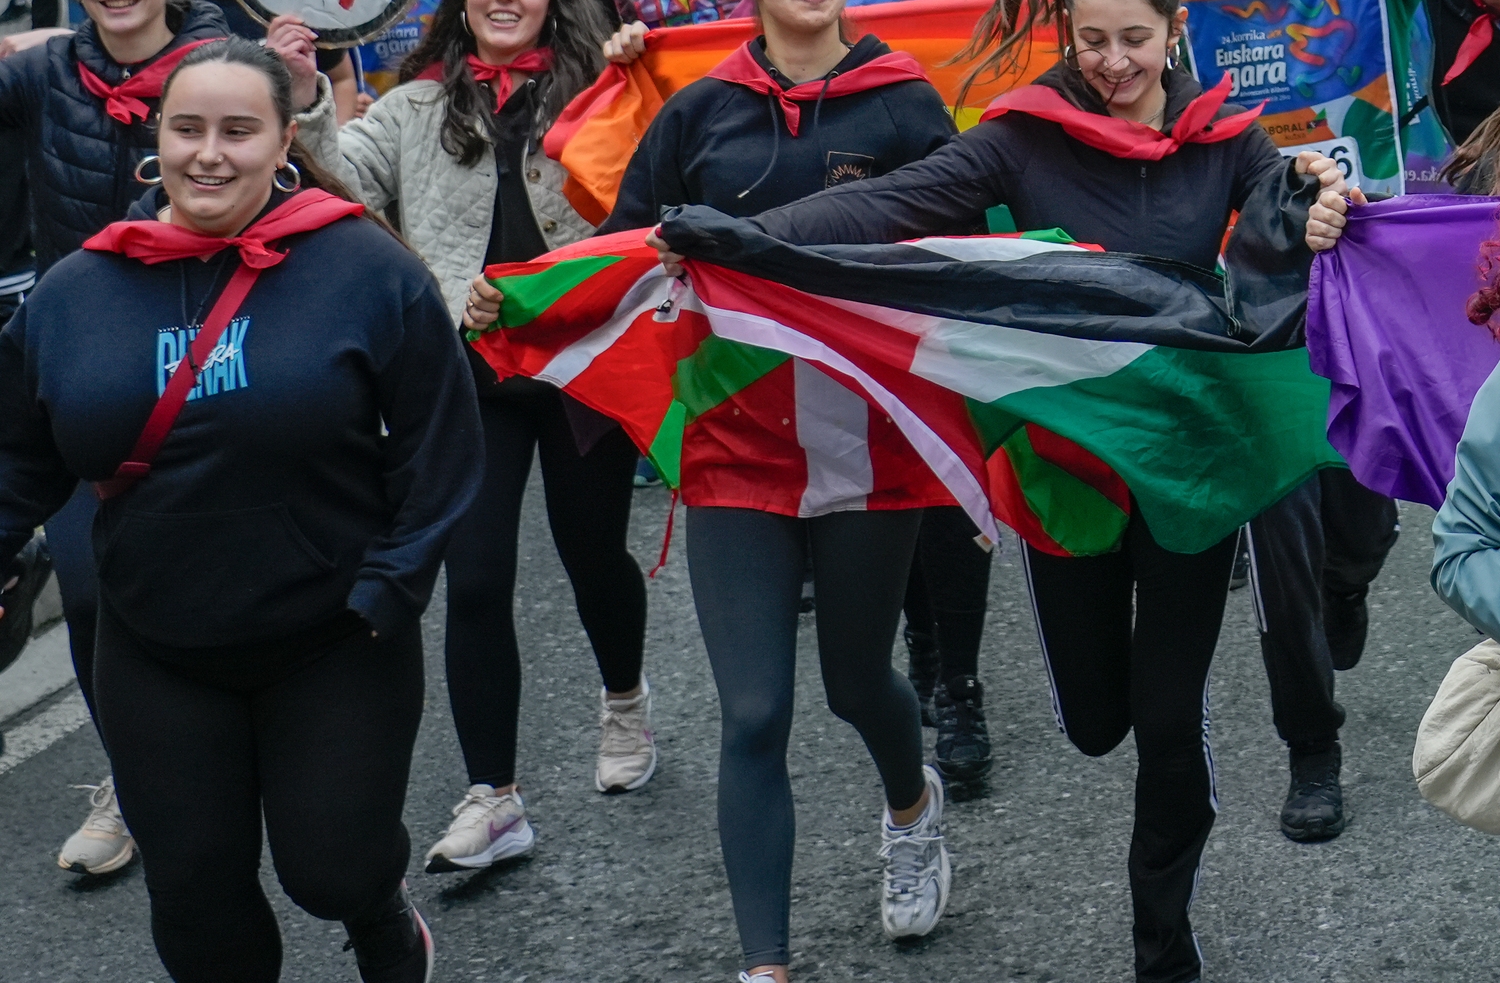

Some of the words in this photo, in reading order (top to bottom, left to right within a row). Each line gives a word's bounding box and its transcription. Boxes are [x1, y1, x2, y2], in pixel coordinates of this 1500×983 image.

[1221, 29, 1266, 45] 24.korrika
[1215, 43, 1284, 67] Euskara
[1228, 61, 1287, 97] gara
[1263, 122, 1304, 135] BORAL
